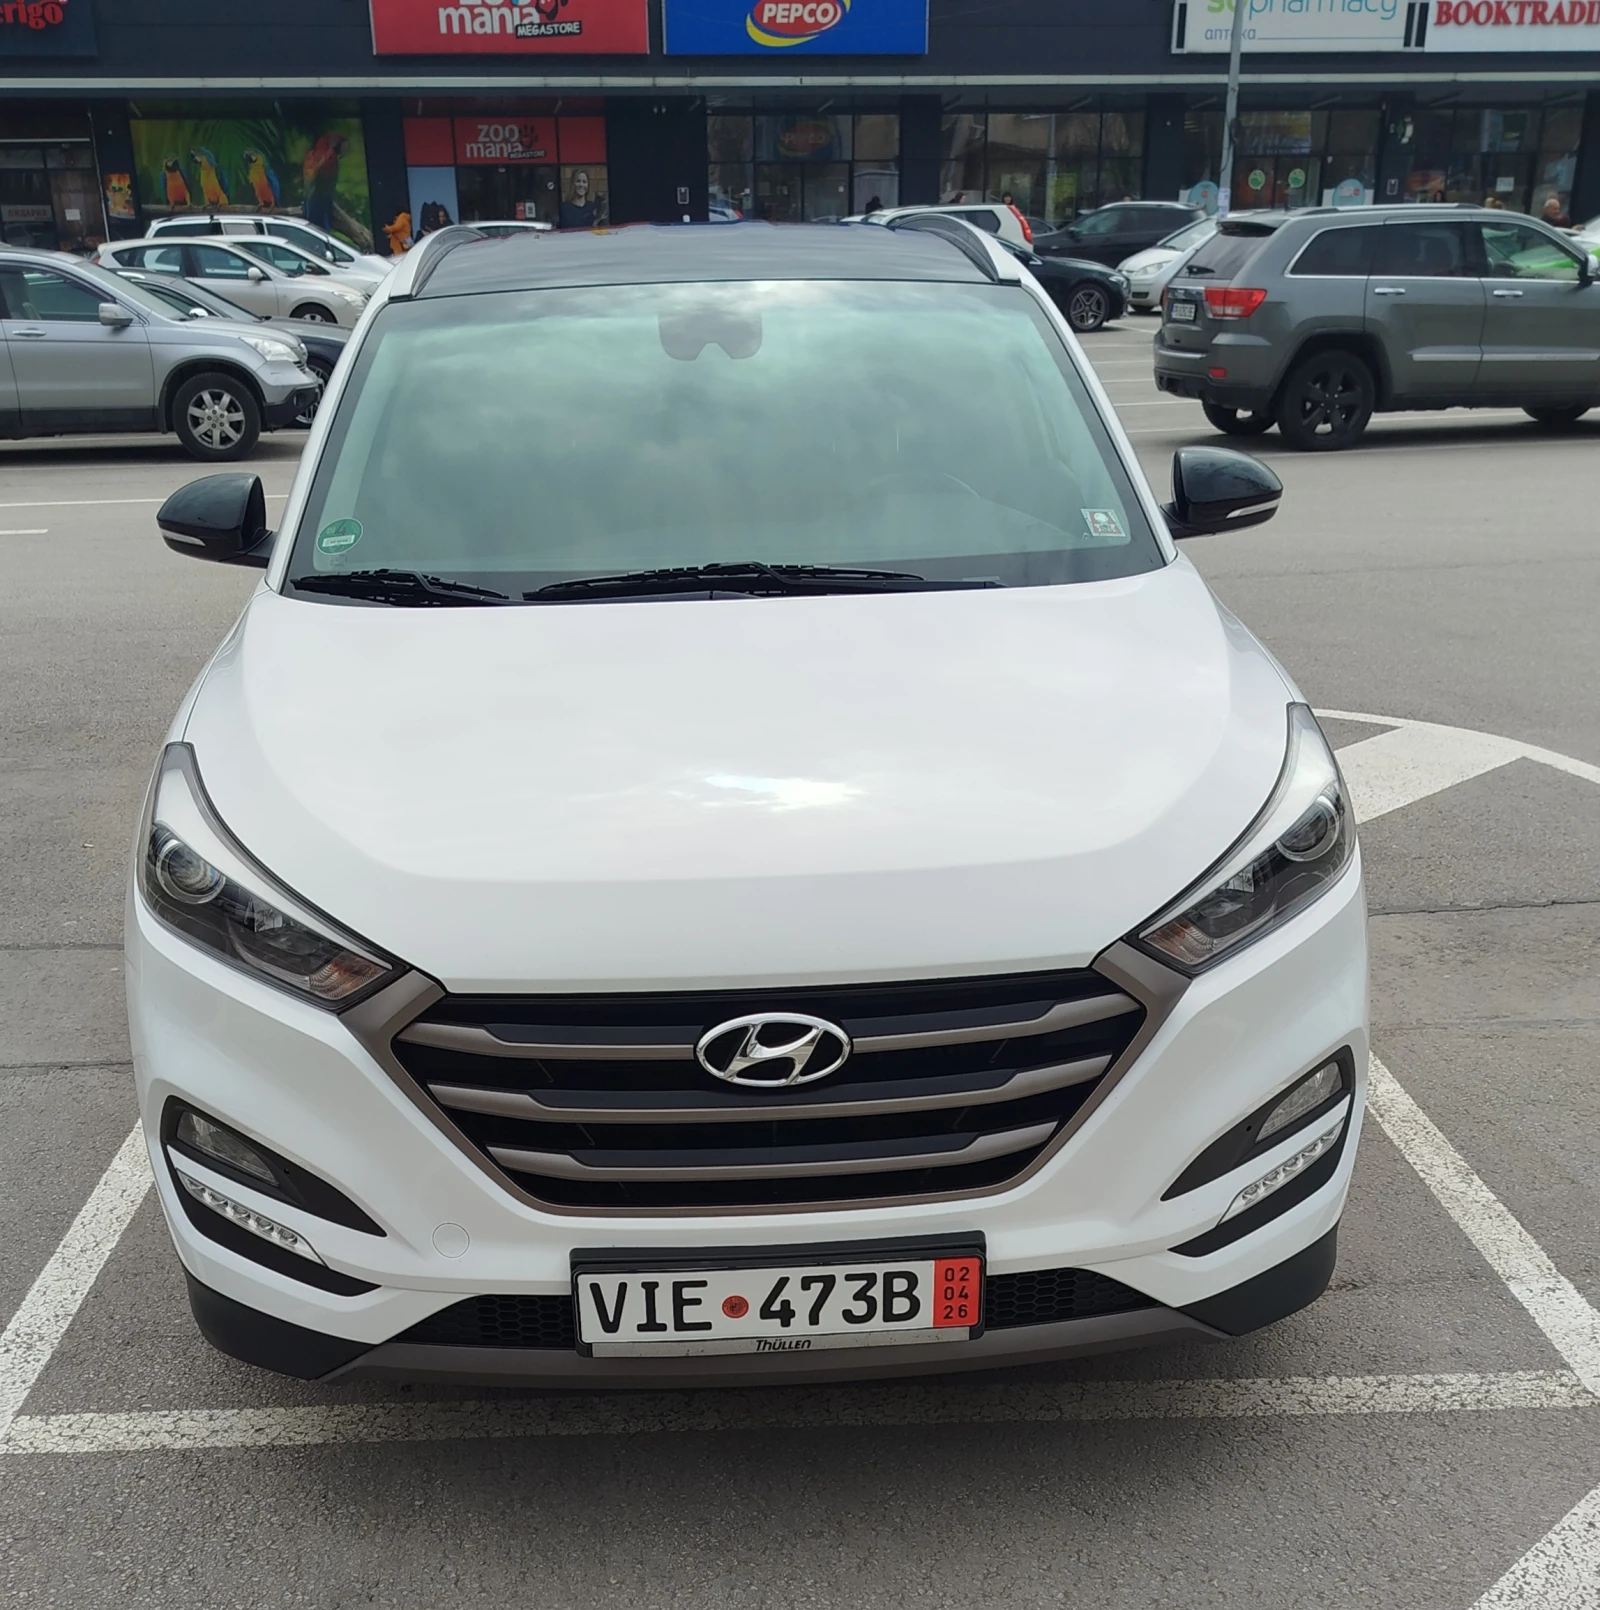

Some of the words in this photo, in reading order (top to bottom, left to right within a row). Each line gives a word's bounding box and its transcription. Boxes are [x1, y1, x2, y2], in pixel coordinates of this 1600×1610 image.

[0, 0, 64, 30] rigo
[438, 6, 541, 35] mania
[762, 3, 835, 24] PEPCO
[1434, 0, 1600, 26] BOOKTRADI
[517, 21, 581, 37] MEGASTORE
[1204, 28, 1257, 41] аптка
[466, 142, 523, 158] mania
[944, 1266, 970, 1282] 02
[943, 1285, 969, 1301] 04
[589, 1279, 712, 1334] VIE
[759, 1271, 921, 1328] 473B
[943, 1303, 968, 1320] 26
